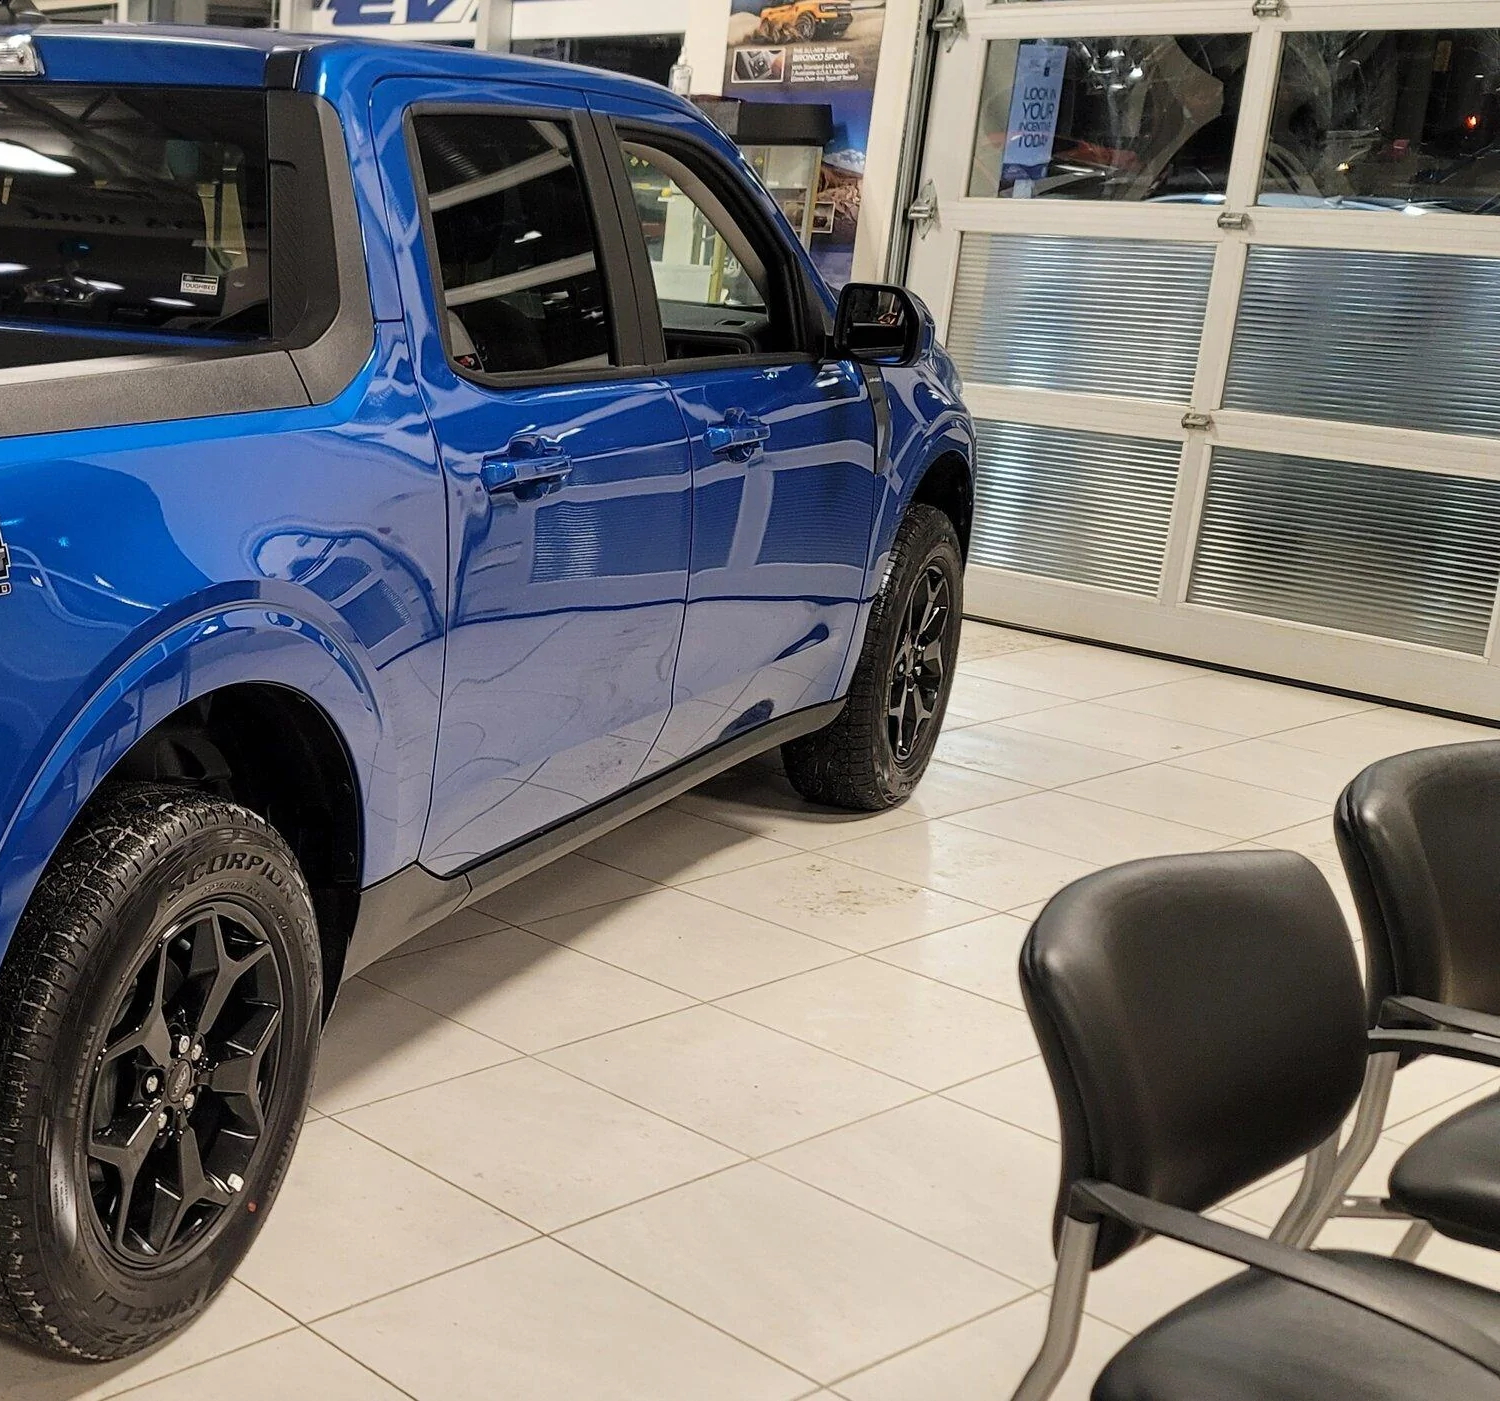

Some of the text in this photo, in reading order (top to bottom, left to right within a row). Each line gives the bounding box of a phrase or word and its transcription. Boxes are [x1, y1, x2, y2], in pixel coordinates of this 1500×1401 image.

[792, 51, 848, 61] BRONCO SPORT
[1023, 86, 1049, 100] LOCK
[1022, 101, 1055, 120] YOUR
[182, 282, 216, 291] TOUGHBED
[166, 852, 297, 904] SCORPION
